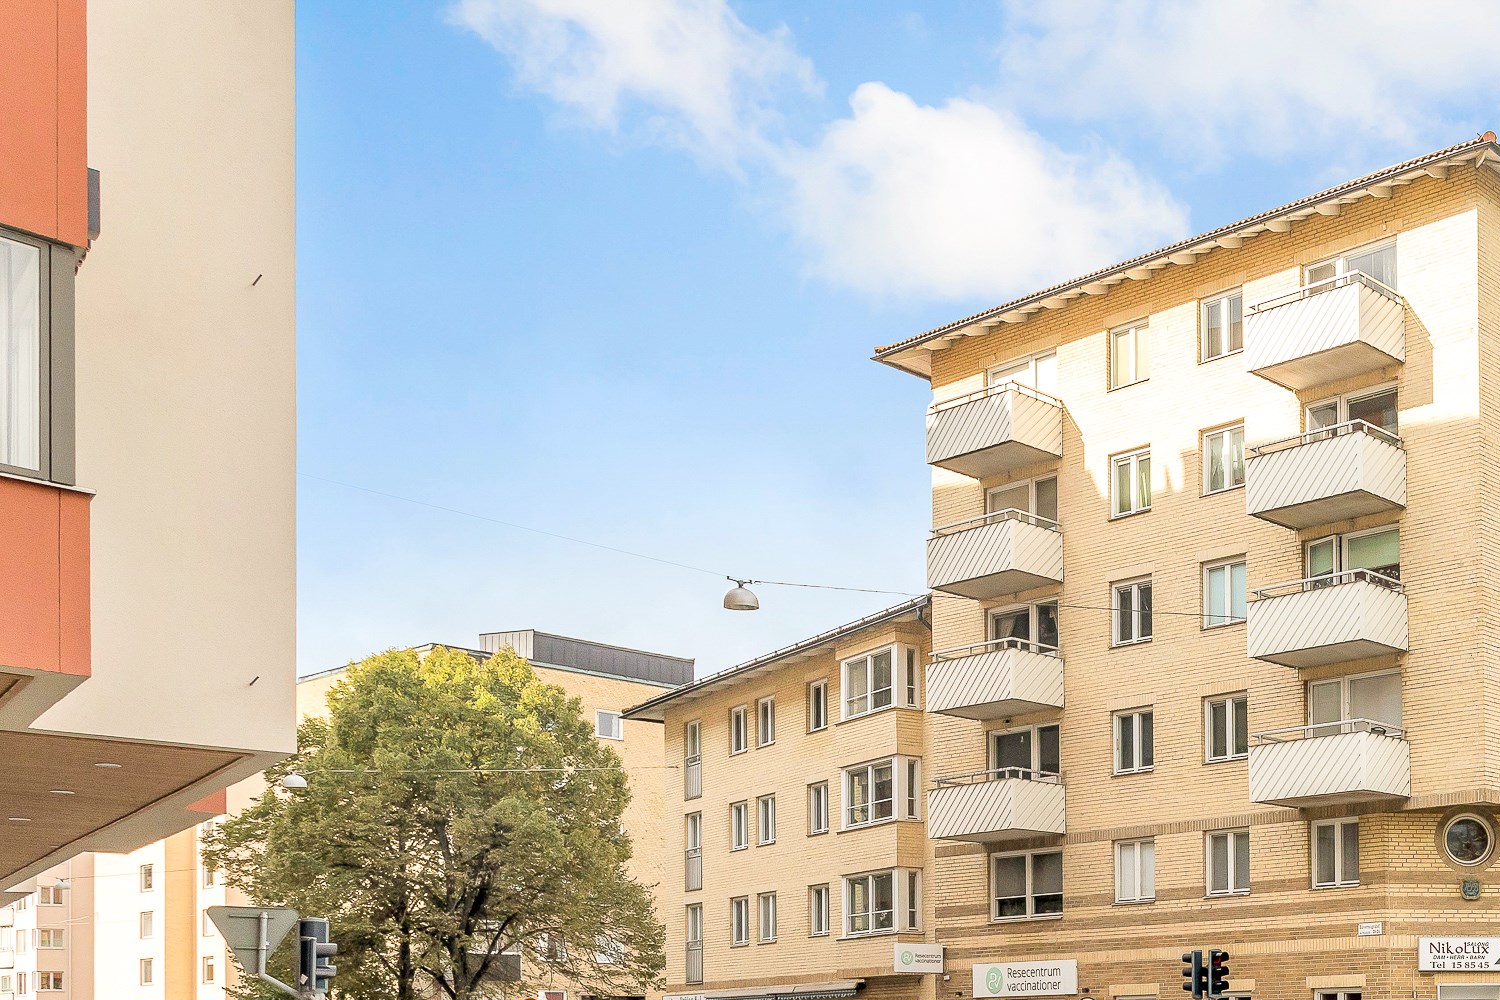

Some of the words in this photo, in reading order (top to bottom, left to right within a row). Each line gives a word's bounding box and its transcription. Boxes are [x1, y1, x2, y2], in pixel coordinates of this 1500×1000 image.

[1429, 942, 1489, 954] NikoLux
[1007, 967, 1061, 979] Resecentrum
[1007, 980, 1062, 992] vaccinationer
